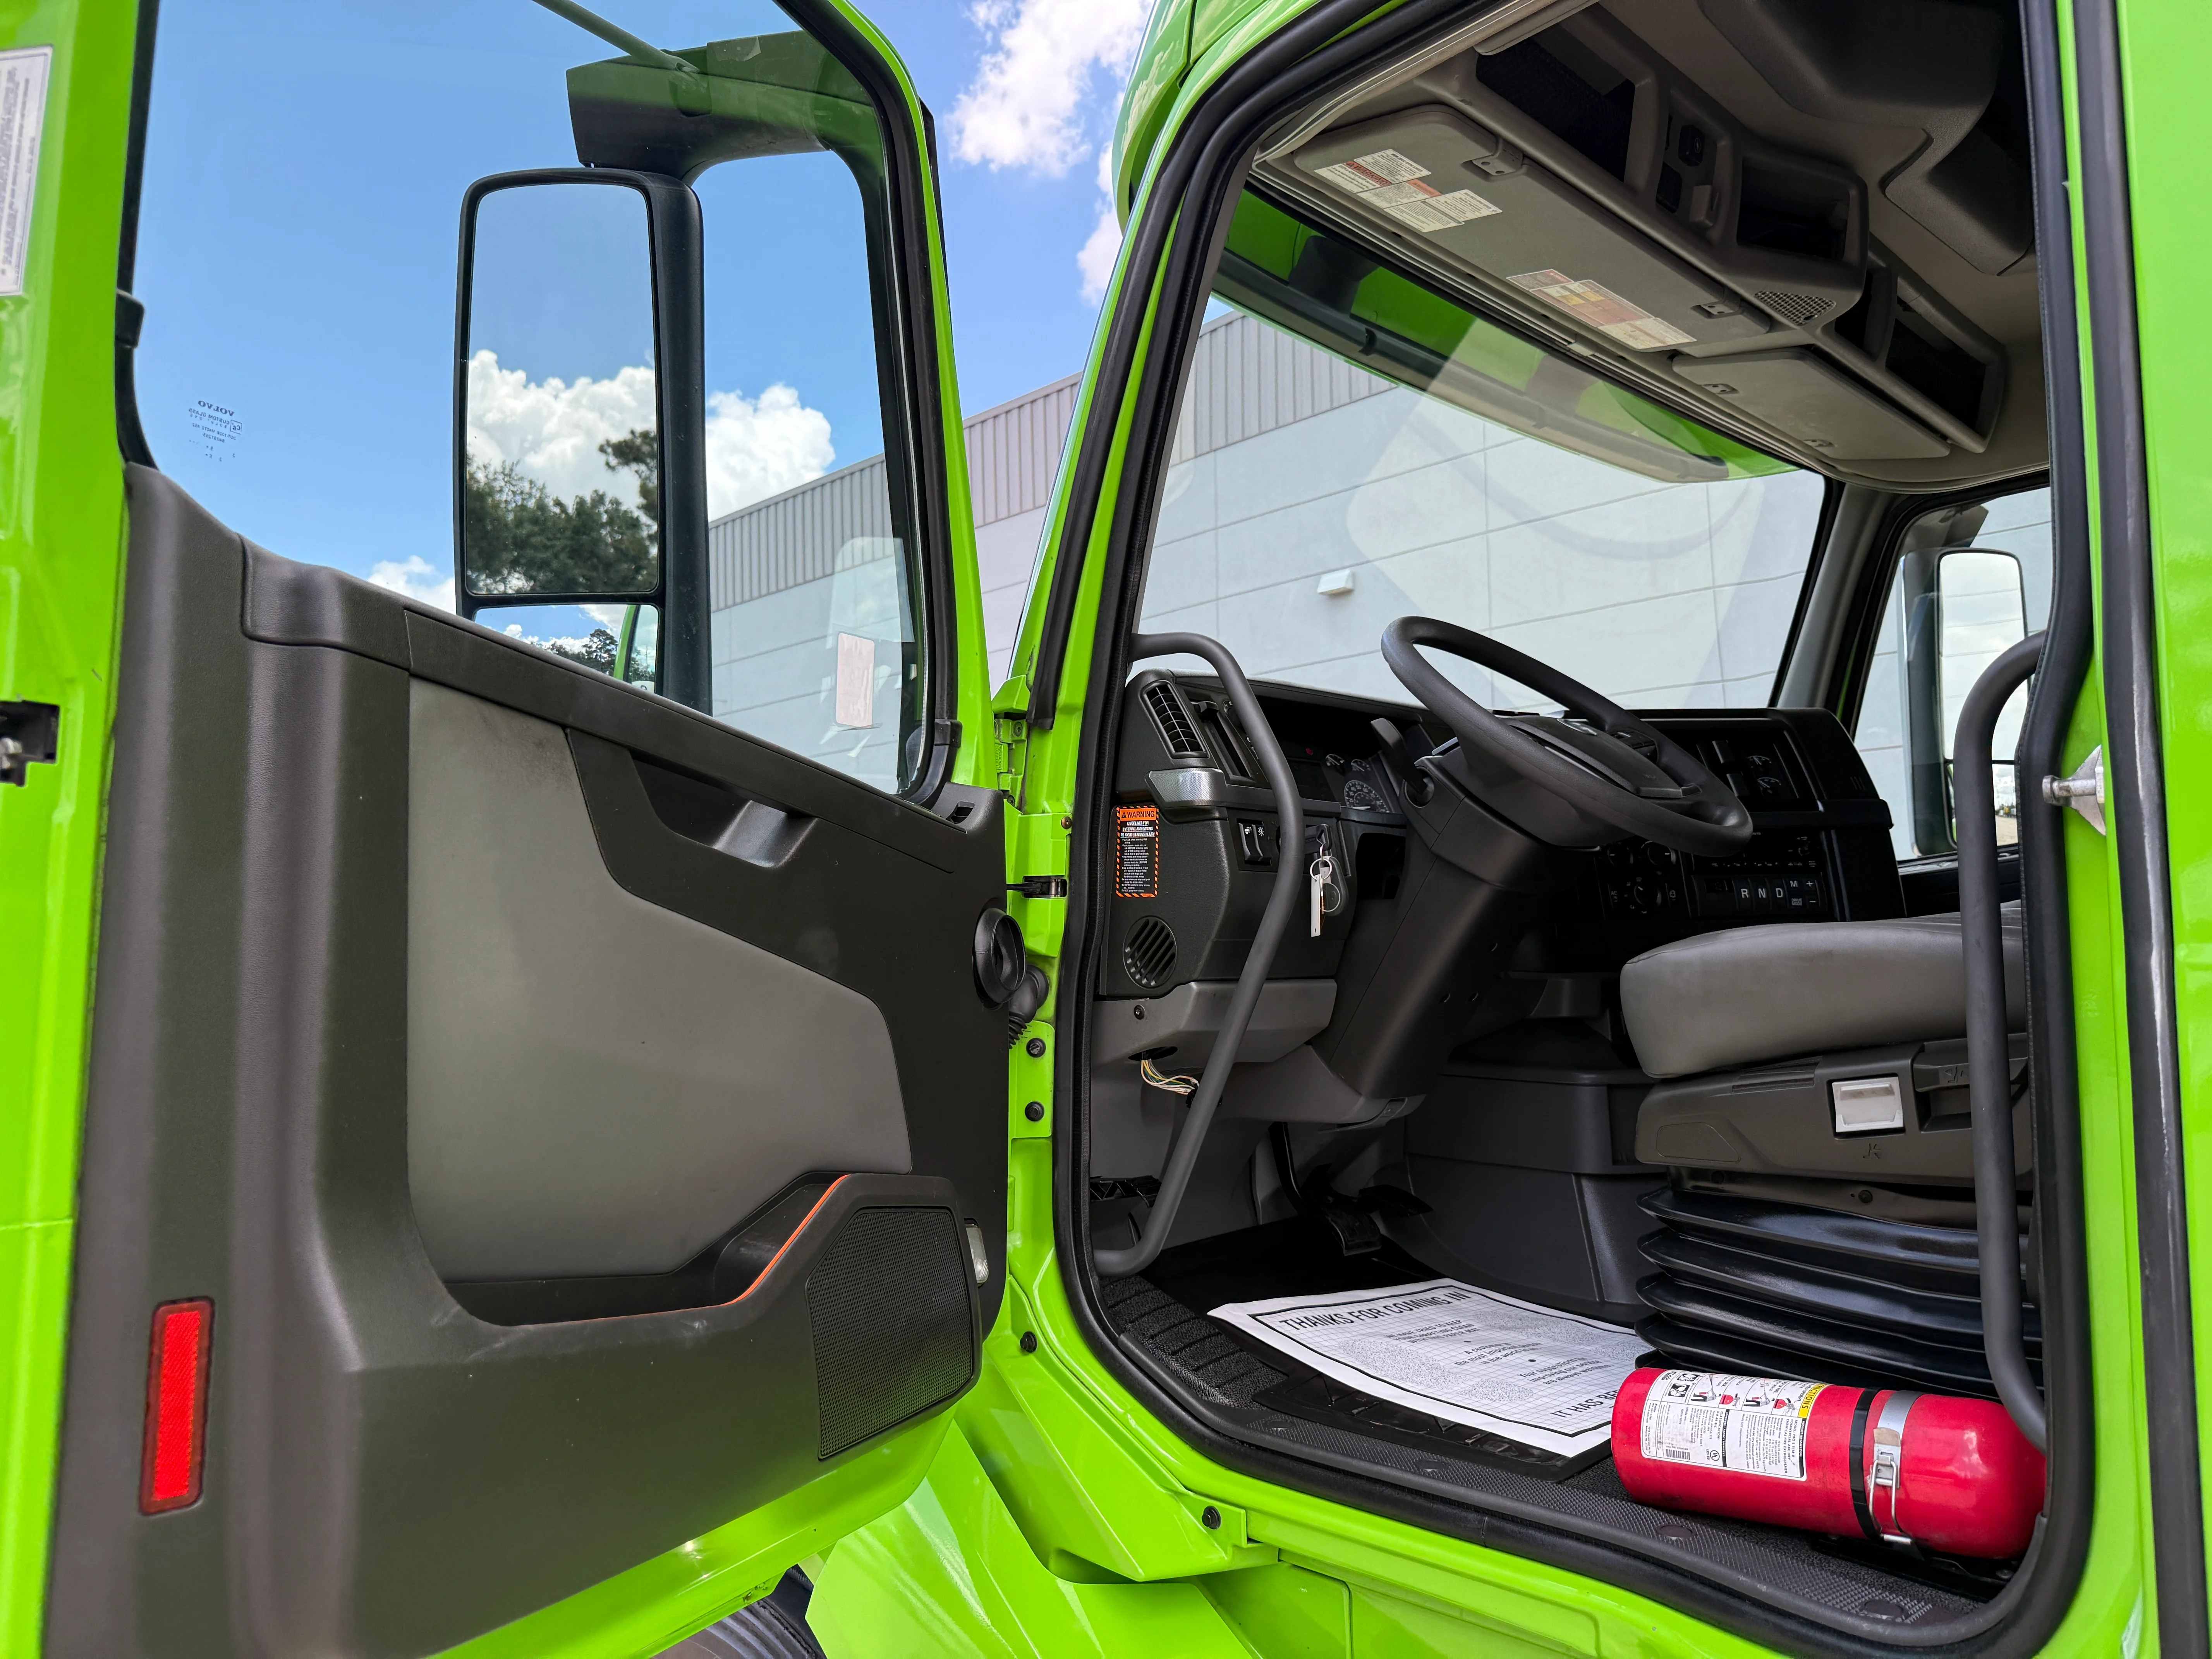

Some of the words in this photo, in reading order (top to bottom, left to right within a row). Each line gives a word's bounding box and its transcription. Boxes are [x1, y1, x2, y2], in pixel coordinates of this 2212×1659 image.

[1741, 888, 1750, 899] R
[1758, 888, 1767, 898] N
[1776, 888, 1784, 898] D
[1279, 1313, 1353, 1330] THANKS
[1350, 1309, 1391, 1321] FOR
[1383, 1297, 1451, 1313] COMING
[1447, 1291, 1472, 1302] IN
[1415, 1328, 1452, 1338] CARPETING
[1468, 1353, 1488, 1362] most
[1484, 1345, 1519, 1355] important
[1535, 1358, 1577, 1372] suggestions
[1528, 1369, 1566, 1382] improving
[1555, 1372, 1582, 1381] always
[1550, 1410, 1573, 1418] IT
[1566, 1398, 1604, 1413] HAS
